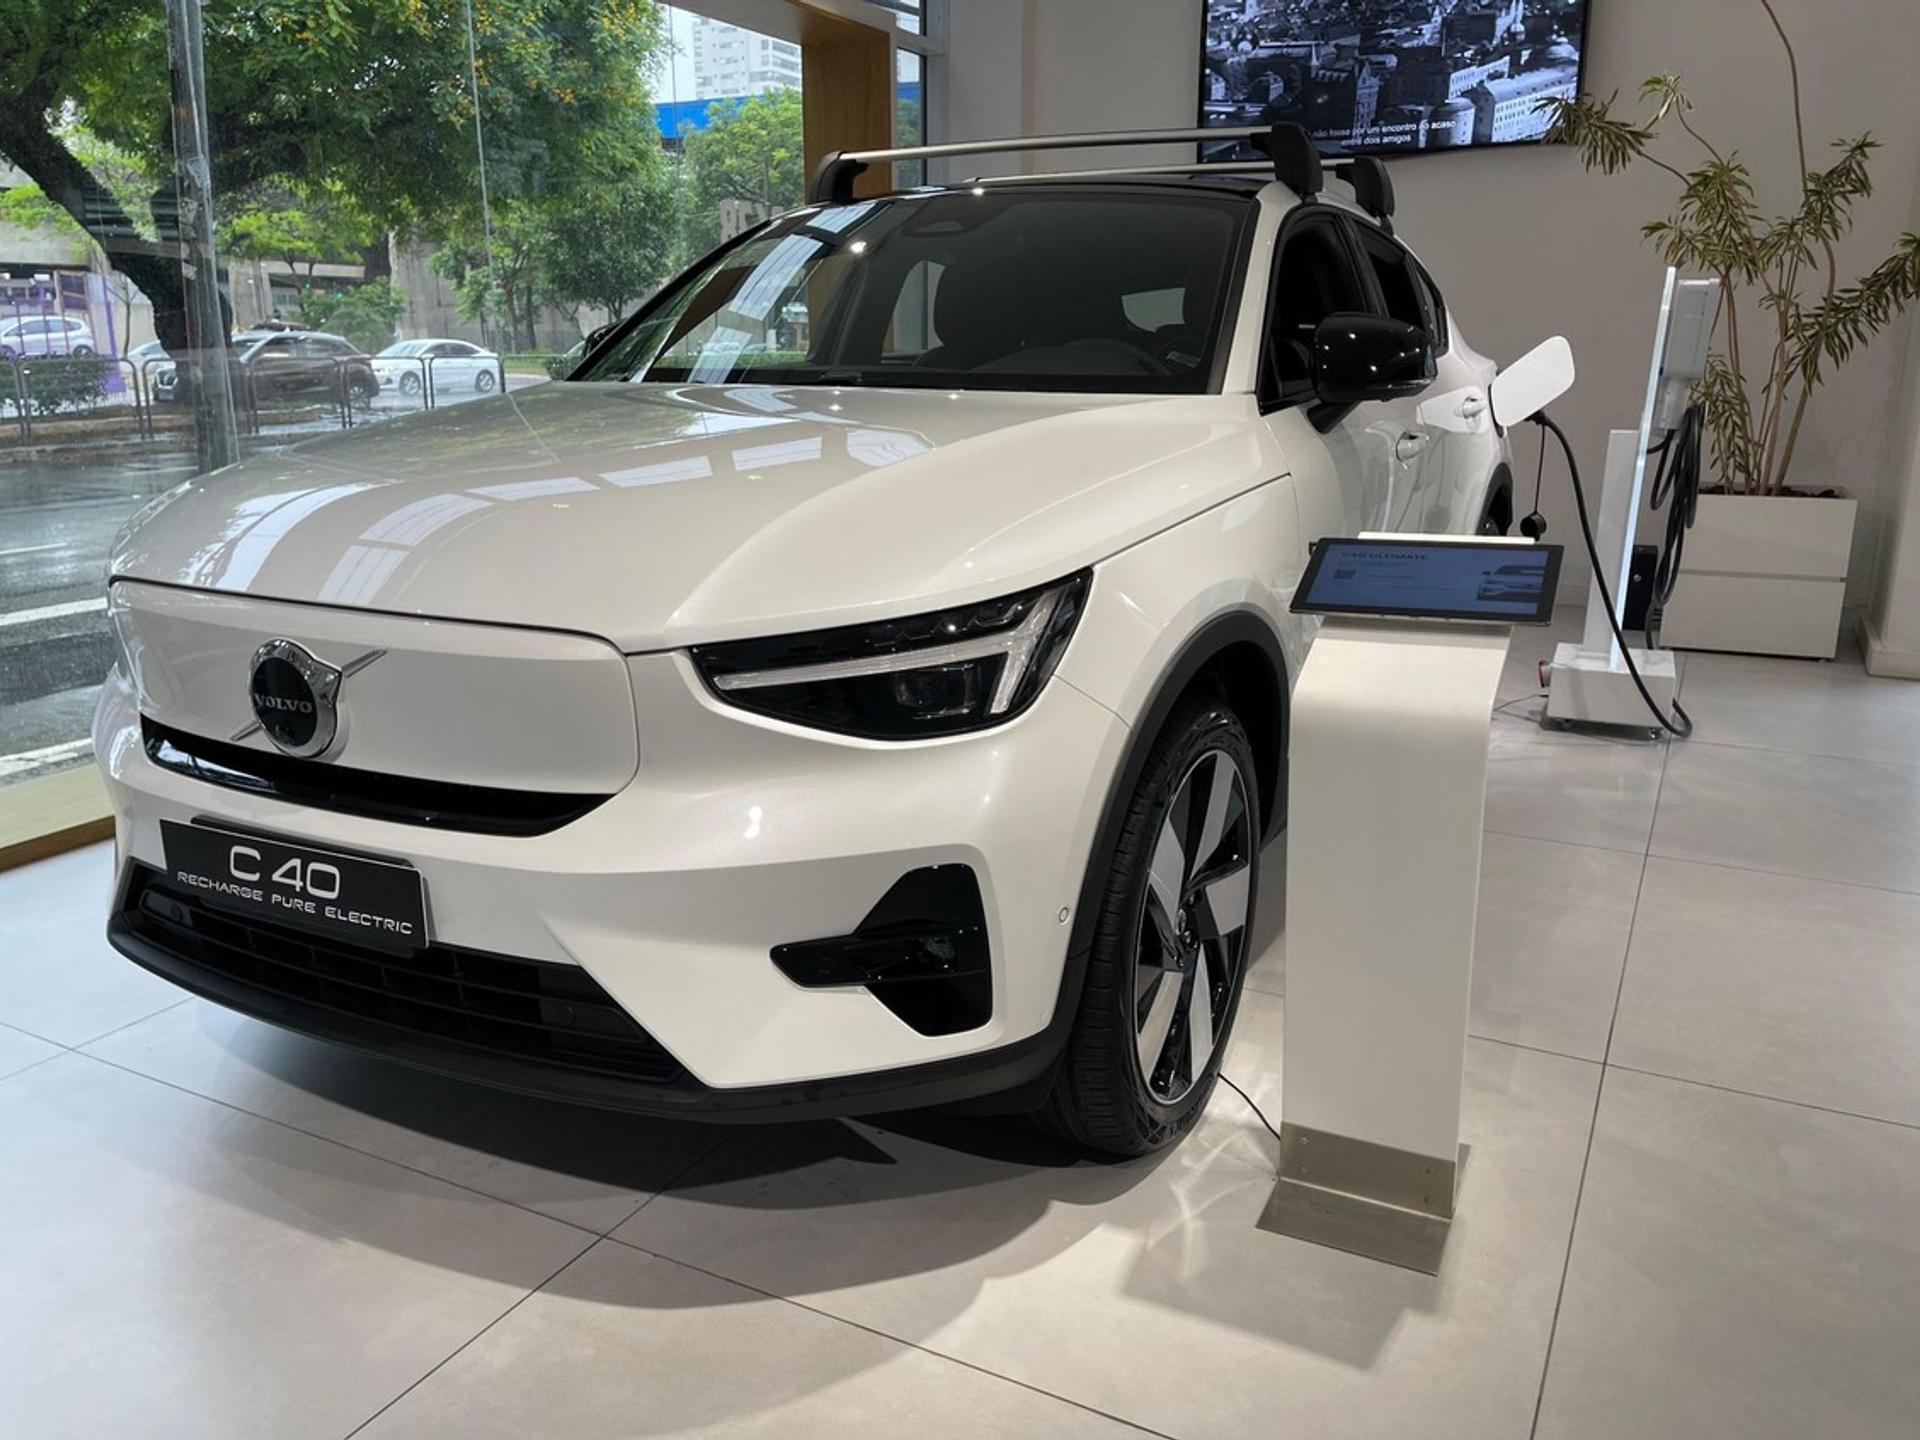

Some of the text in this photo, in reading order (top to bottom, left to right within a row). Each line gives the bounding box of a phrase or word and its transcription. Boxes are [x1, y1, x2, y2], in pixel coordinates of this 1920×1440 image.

[1329, 128, 1350, 137] fosse
[1367, 126, 1380, 134] um
[1382, 123, 1417, 133] encontro
[1431, 120, 1456, 129] acaso
[1364, 135, 1380, 144] dois
[1382, 134, 1412, 145] amigos
[1369, 552, 1428, 560] ULTIMATE
[253, 693, 313, 713] VOLVO
[229, 845, 340, 900] C 40
[177, 871, 413, 935] RECHARGE PURE ELECTRIC
